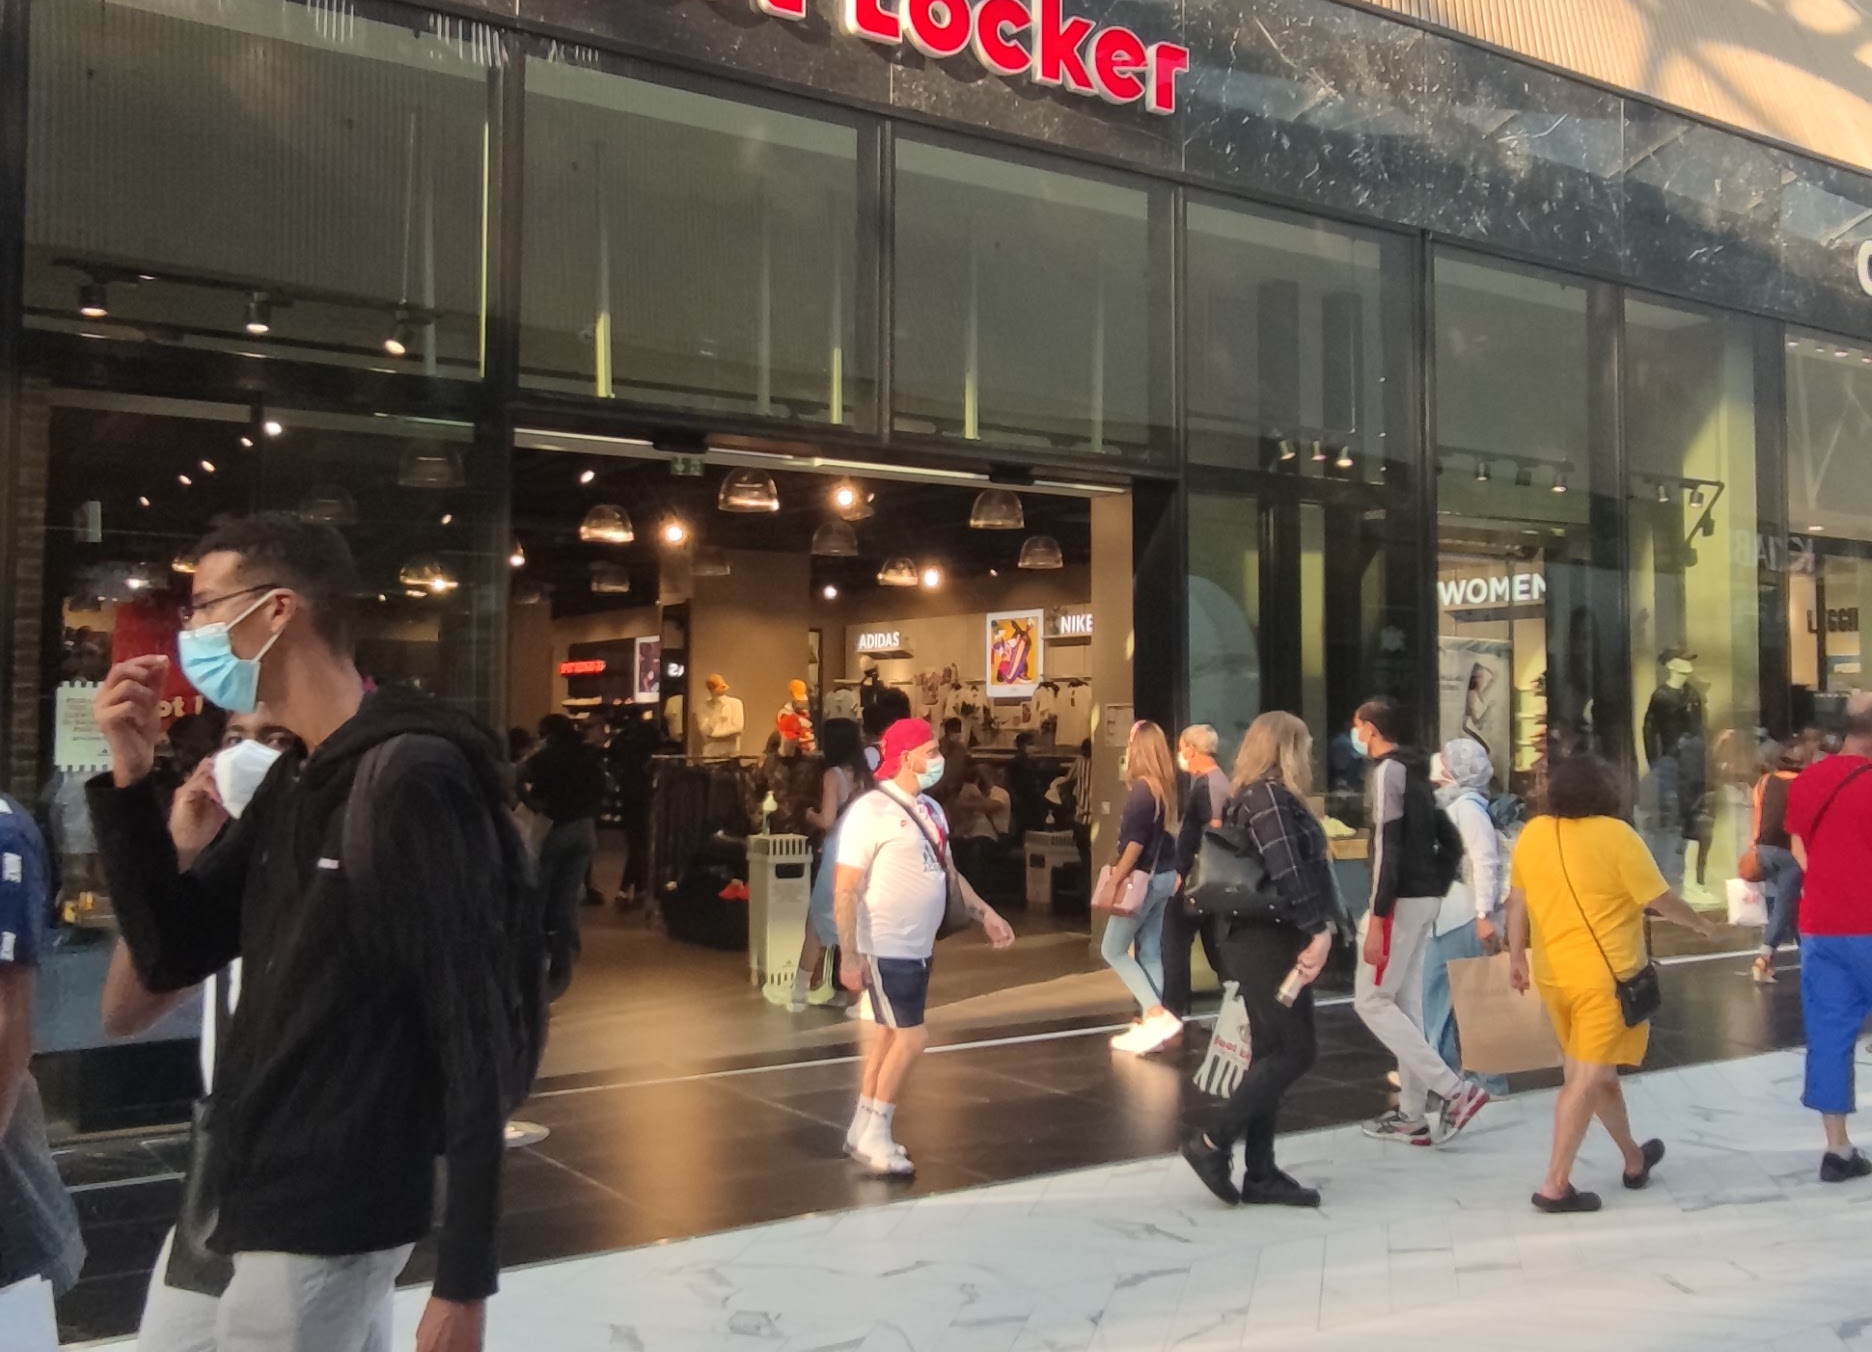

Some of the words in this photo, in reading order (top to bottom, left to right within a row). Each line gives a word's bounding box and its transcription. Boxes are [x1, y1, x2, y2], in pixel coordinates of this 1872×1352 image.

[1438, 572, 1546, 606] WOMEN
[1060, 614, 1093, 634] NIKE
[859, 631, 900, 649] ADIDAS
